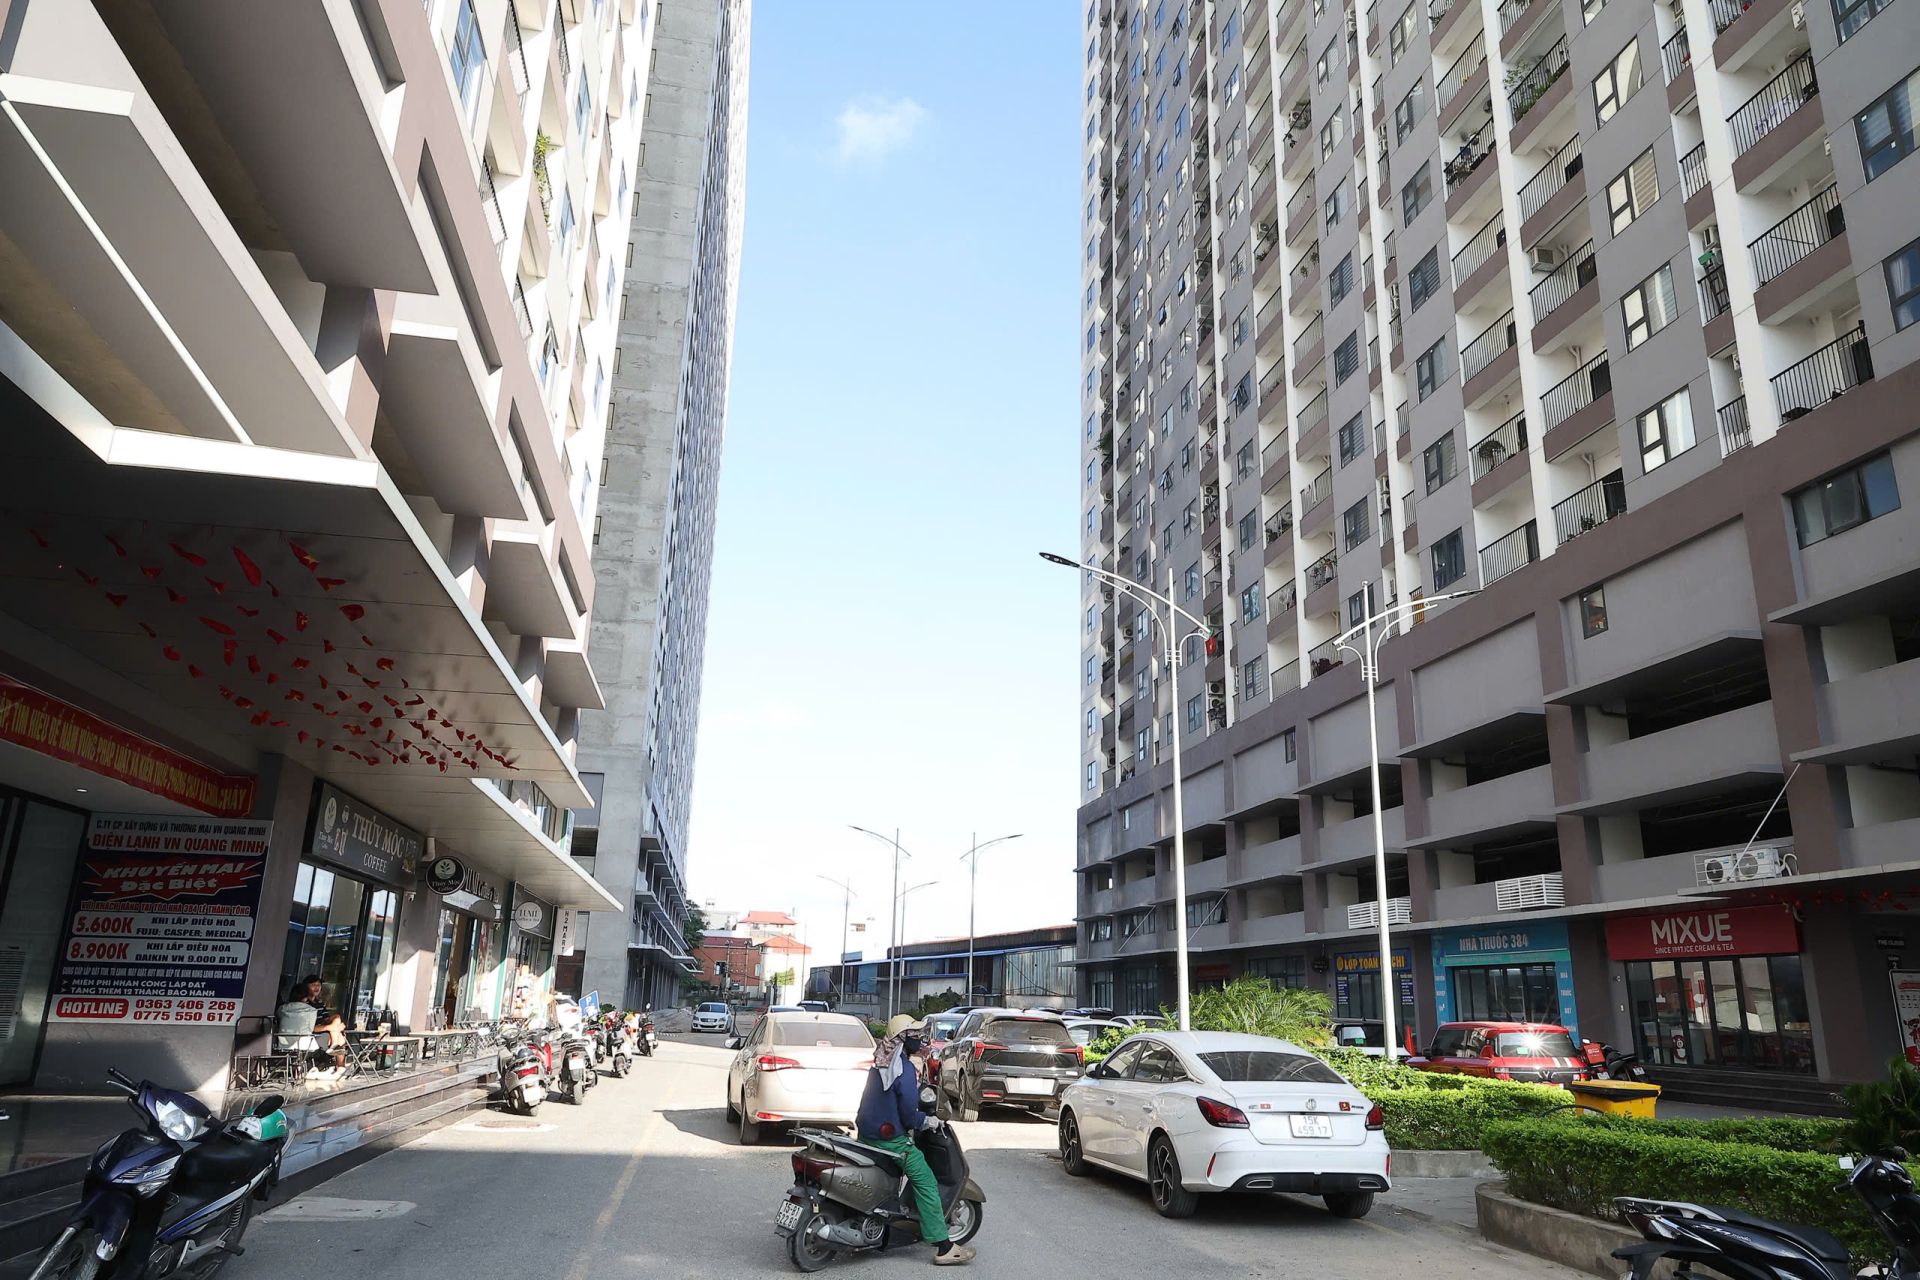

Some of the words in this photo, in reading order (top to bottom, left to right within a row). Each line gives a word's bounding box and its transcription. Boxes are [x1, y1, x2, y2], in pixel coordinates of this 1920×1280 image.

[213, 825, 223, 834] VN
[224, 825, 247, 836] QUANG
[93, 831, 124, 850] ĐIỆN
[127, 835, 161, 851] LẠNH
[164, 837, 181, 850] VN
[184, 838, 227, 852] QUANG
[230, 839, 265, 853] MINH
[381, 828, 405, 861] MỘC
[103, 861, 198, 879] KHUYẾN
[199, 862, 246, 876] MẠI
[363, 853, 388, 874] COFFEE
[120, 880, 165, 893] Đặc
[169, 876, 217, 891] Biệt
[182, 904, 198, 914] 384
[76, 916, 135, 935] 5.600K
[151, 917, 170, 926] KHI
[205, 930, 247, 939] MEDICAL
[1650, 913, 1733, 945] MIXUE
[146, 942, 164, 951] KHI
[1459, 935, 1478, 951] NHÀ
[1479, 930, 1508, 951] THUỐC
[1510, 933, 1529, 949] 384
[70, 942, 130, 960] 8.900K
[1694, 944, 1715, 952] CREAM
[1722, 943, 1735, 951] TEA
[135, 954, 168, 963] DAIKIN
[171, 955, 184, 963] VN
[187, 955, 216, 964] 9.000
[219, 956, 239, 965] BTU
[124, 988, 133, 996] 12
[61, 1001, 124, 1015] HOTLINE
[135, 999, 173, 1010] 0363
[176, 1000, 205, 1010] 406
[207, 1001, 236, 1012] 268
[586, 996, 593, 1008] P
[133, 1010, 170, 1021] 0775
[174, 1011, 203, 1021] 550
[206, 1012, 235, 1023] 617
[1302, 1115, 1320, 1126] 15K
